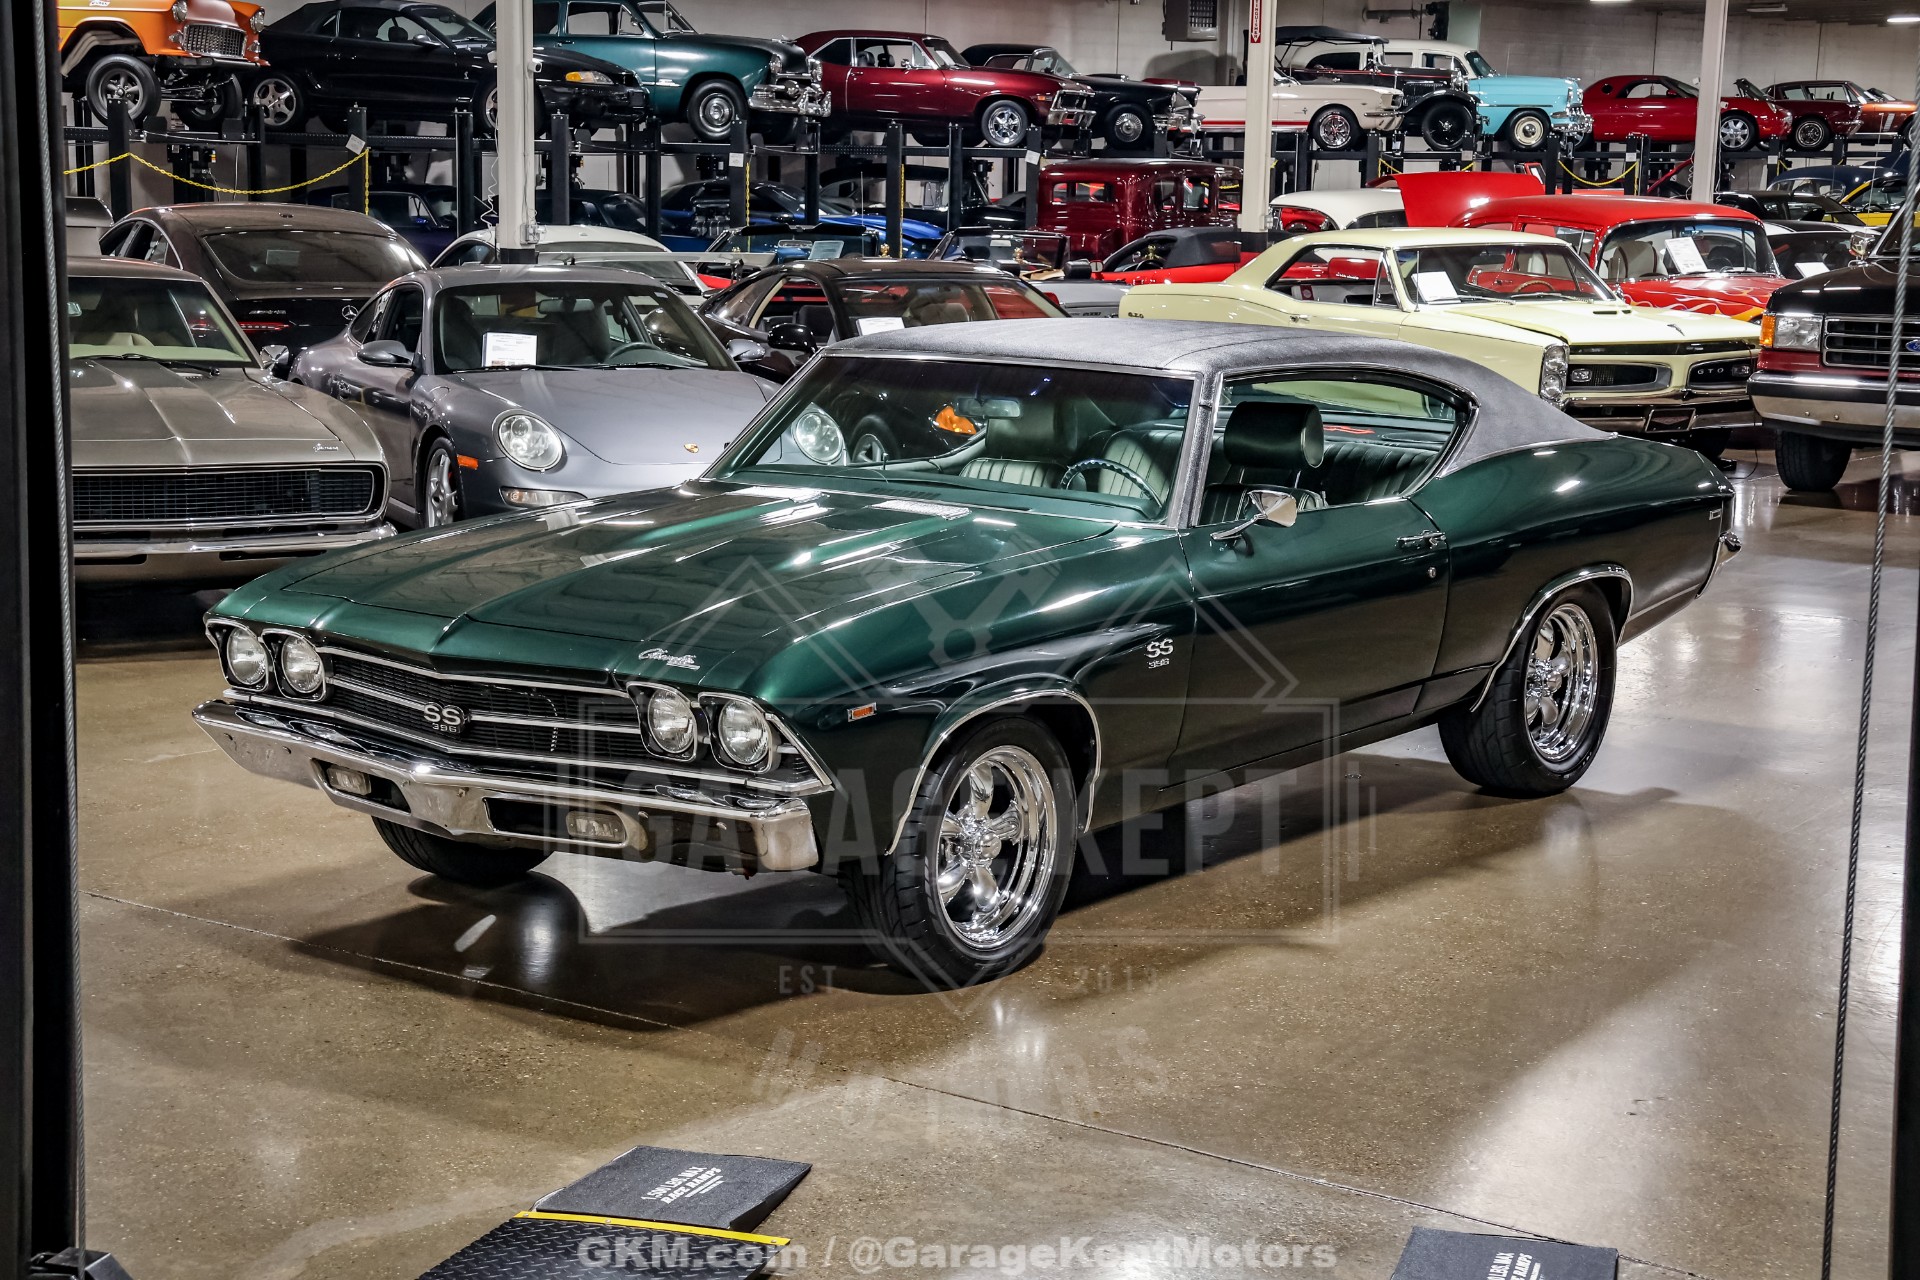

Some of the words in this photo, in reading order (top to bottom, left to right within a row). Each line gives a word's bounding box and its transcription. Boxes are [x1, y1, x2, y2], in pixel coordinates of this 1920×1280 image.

[1697, 367, 1724, 375] GTO
[1144, 637, 1174, 658] SS
[424, 705, 461, 726] SS
[432, 722, 457, 732] 396
